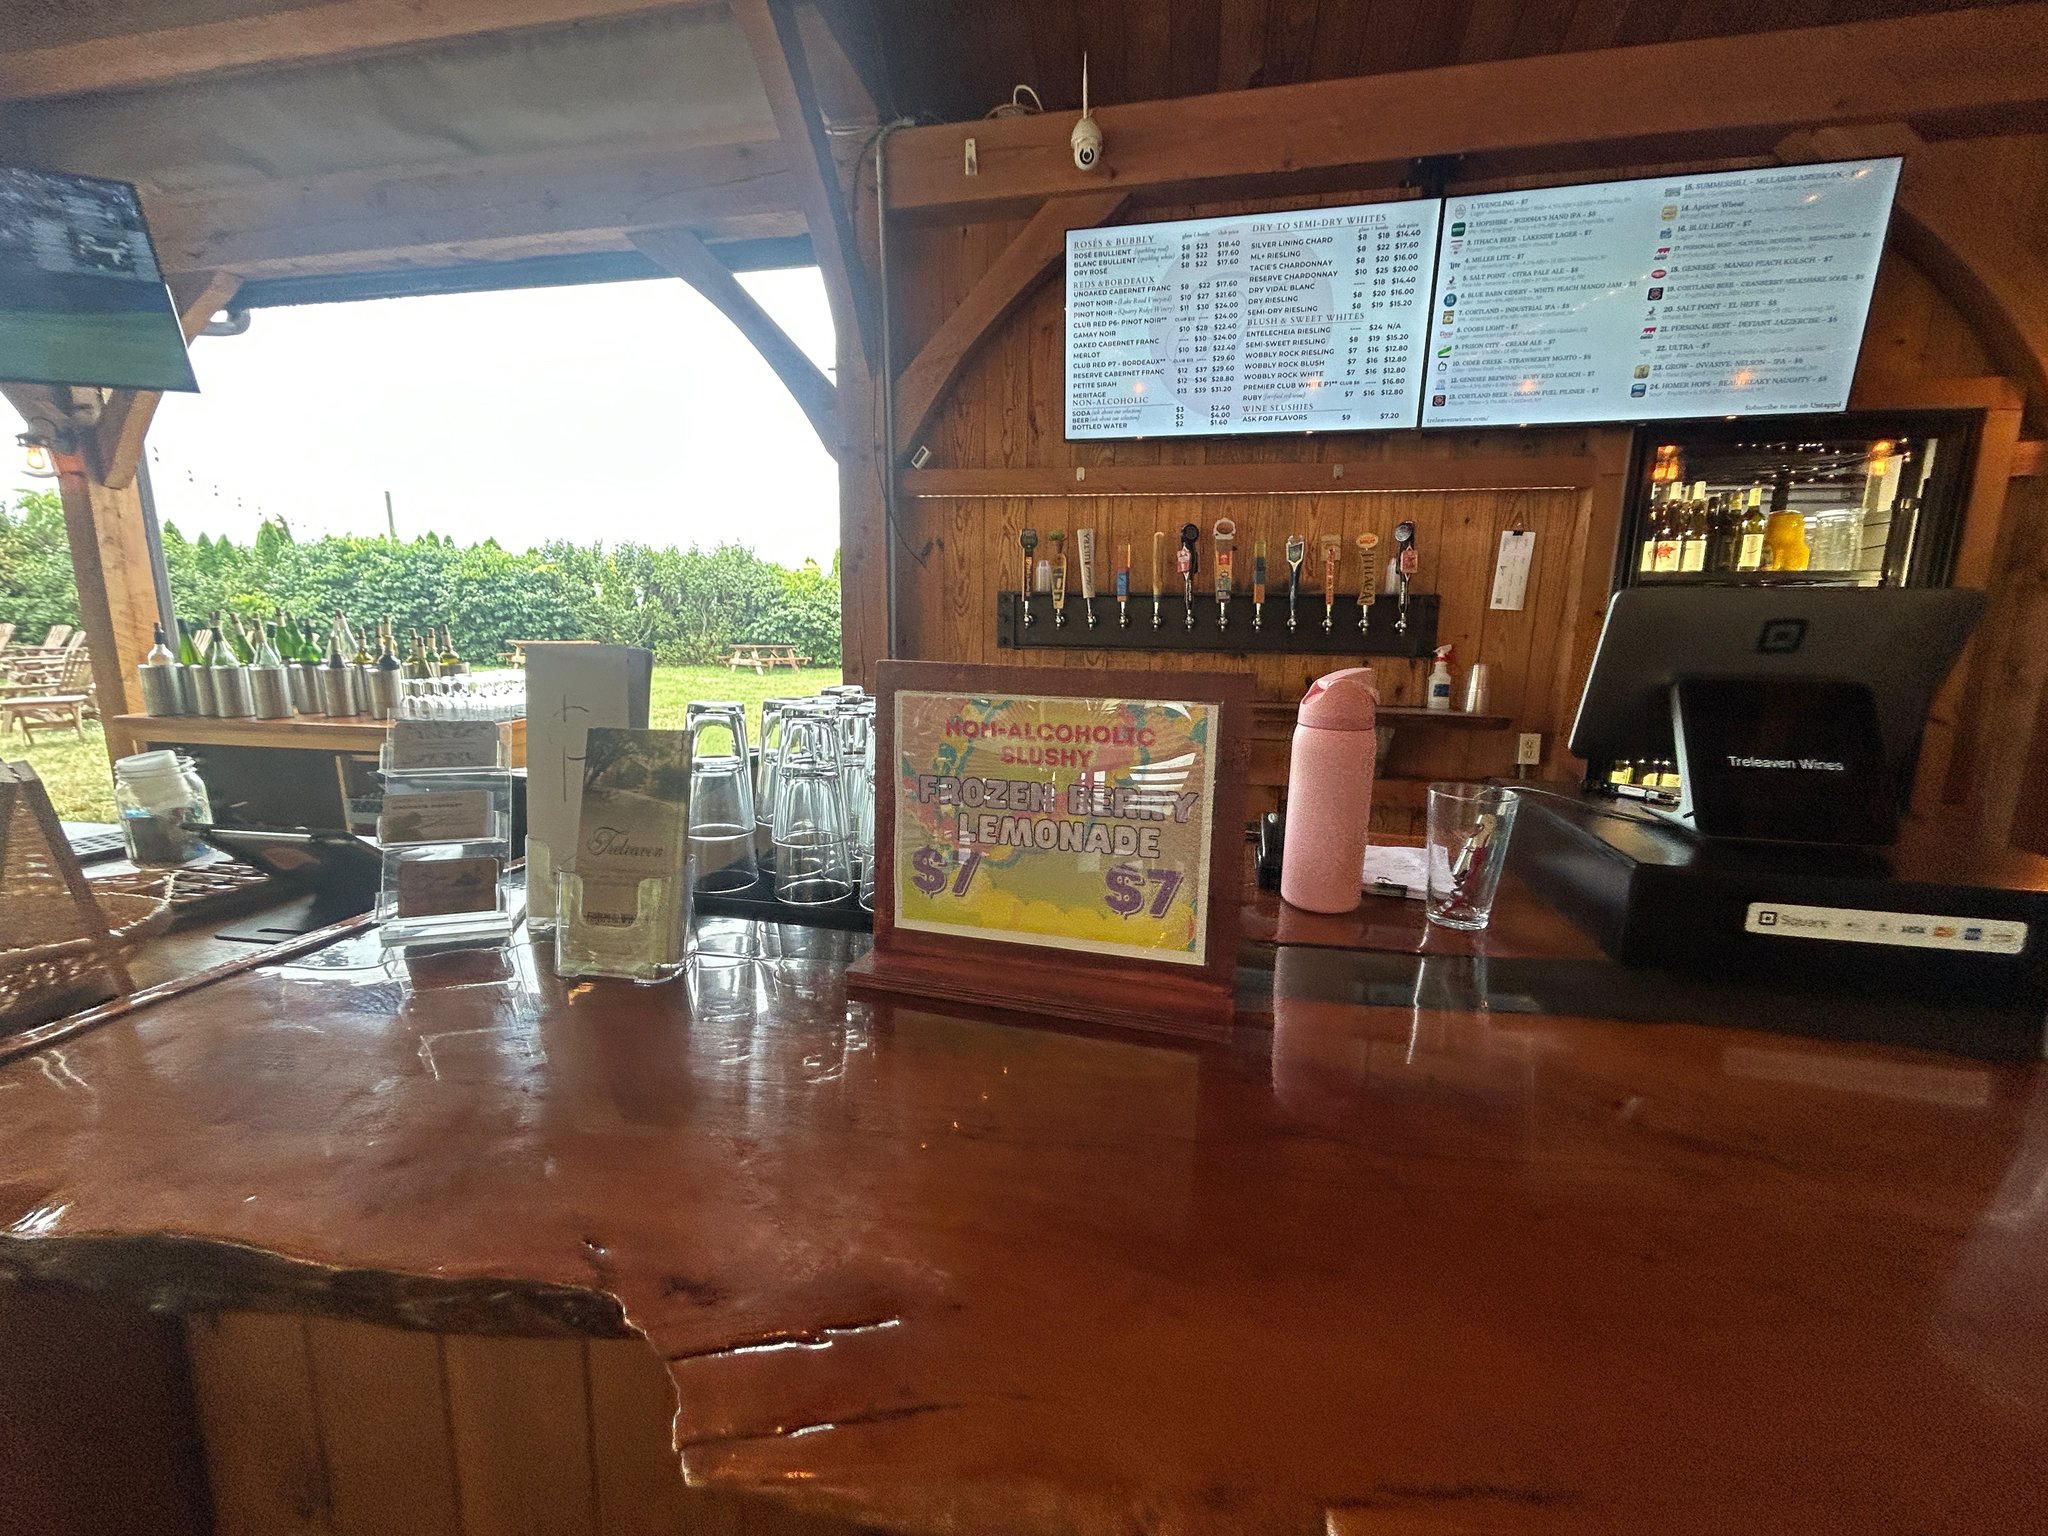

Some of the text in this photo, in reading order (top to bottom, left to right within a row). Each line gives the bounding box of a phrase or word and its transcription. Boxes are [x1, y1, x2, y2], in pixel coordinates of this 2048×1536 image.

[1293, 218, 1343, 229] SEMI-DRY
[1347, 214, 1386, 224] WHITES
[1074, 239, 1103, 249] ROSÉS
[1116, 235, 1155, 246] BUBBLY
[1074, 251, 1092, 259] ROSÉ
[1094, 249, 1131, 258] EBULLIENT
[1267, 251, 1300, 259] RIESLING
[1099, 258, 1136, 266] EBULLIENT
[1279, 260, 1333, 269] CHARDONNAY
[1284, 271, 1338, 280] CHARDONNAY
[1109, 287, 1146, 295] CABERNET
[1248, 318, 1278, 326] BLUSH
[1073, 397, 1149, 406] NON-ALCOHOLIC
[1243, 402, 1313, 412] WINE SLUSHIES
[945, 719, 1156, 747] NON-ALCOHOLIC
[1001, 746, 1094, 767] SLUSHY
[1727, 756, 1844, 771] Treleaven Wines
[919, 775, 1199, 823] FROZEN BERRY
[958, 813, 1161, 858] LEMONADE
[912, 845, 1184, 919] $7 $7
